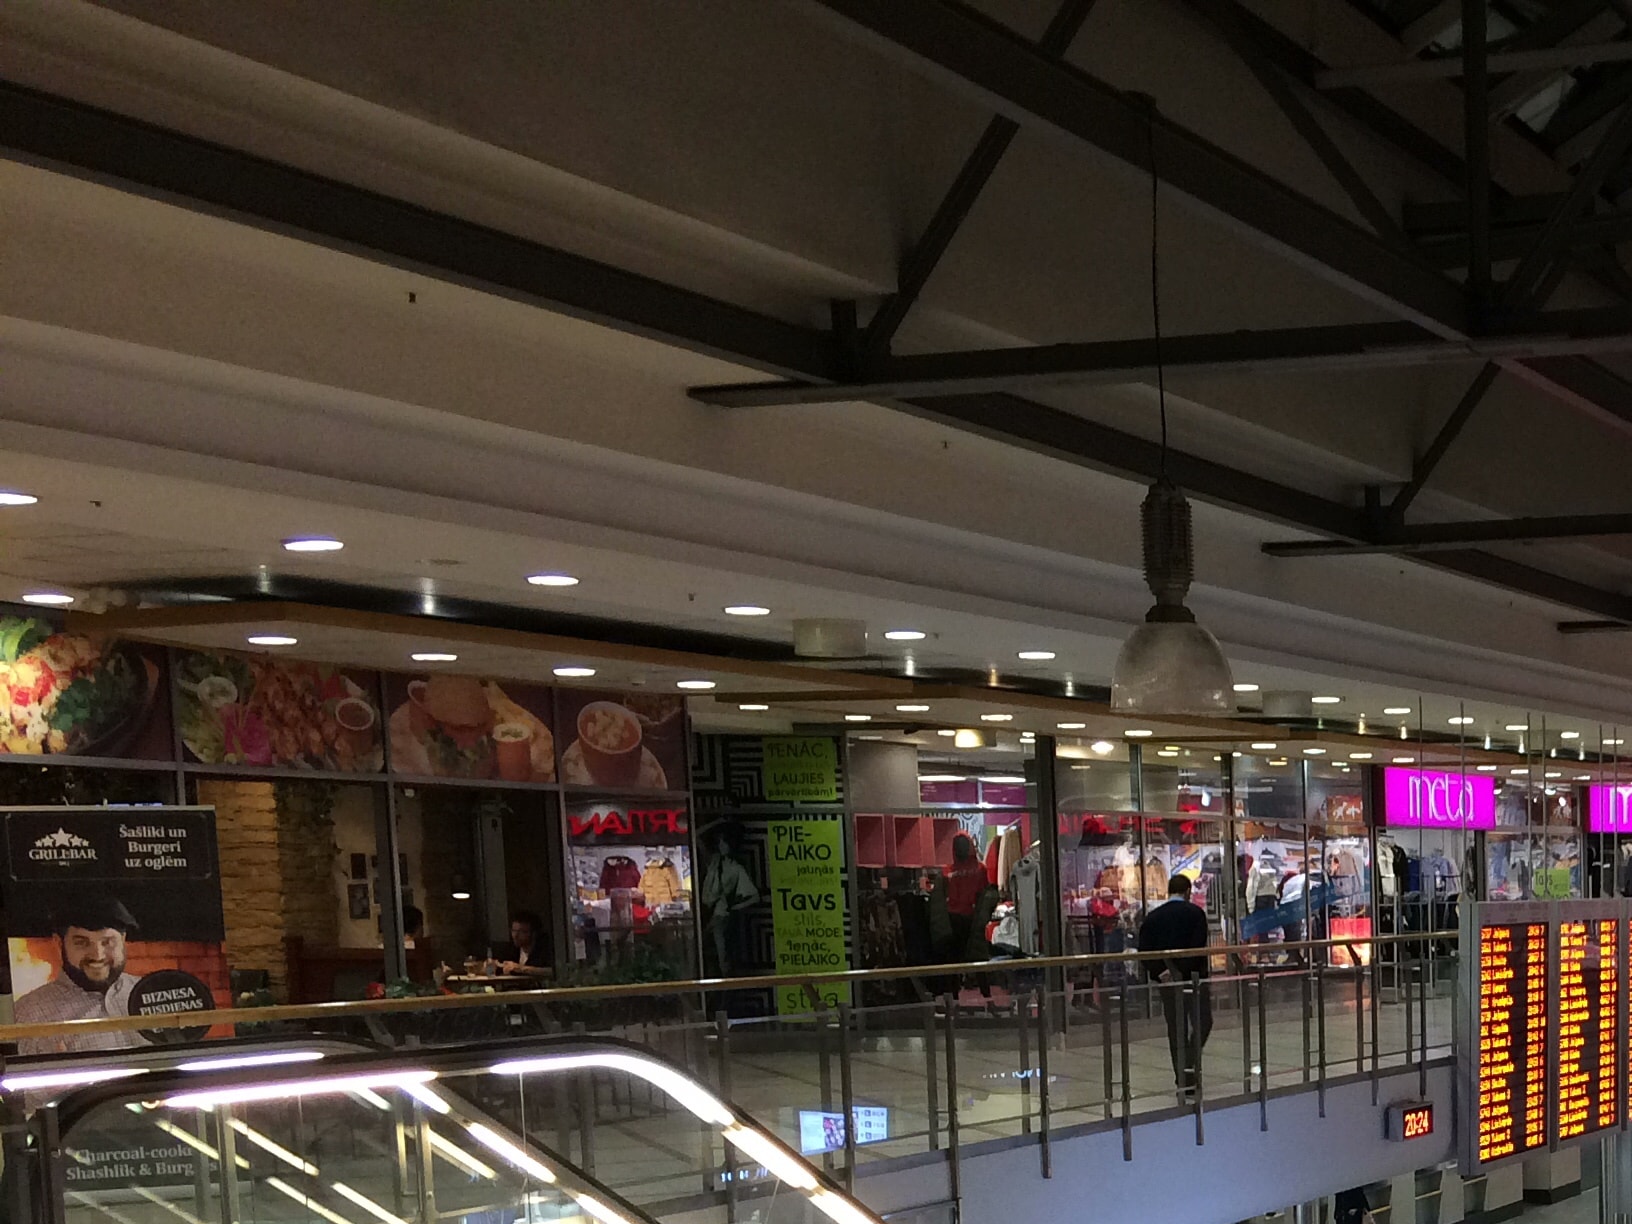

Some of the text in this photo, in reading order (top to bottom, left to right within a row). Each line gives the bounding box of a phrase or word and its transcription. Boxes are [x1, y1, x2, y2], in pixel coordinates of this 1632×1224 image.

[1409, 774, 1475, 821] meta
[119, 824, 187, 838] Šašliki un
[128, 841, 182, 855] Burgeri
[774, 844, 832, 861] LAIKO
[125, 856, 187, 871] uz oglēm
[1535, 871, 1553, 886] Tas
[777, 887, 836, 911] Tavs
[780, 953, 841, 966] PIELAIKO
[141, 986, 196, 1005] BIZNESA
[140, 998, 204, 1016] PUSDIENAS
[66, 1162, 135, 1180] Shashlik
